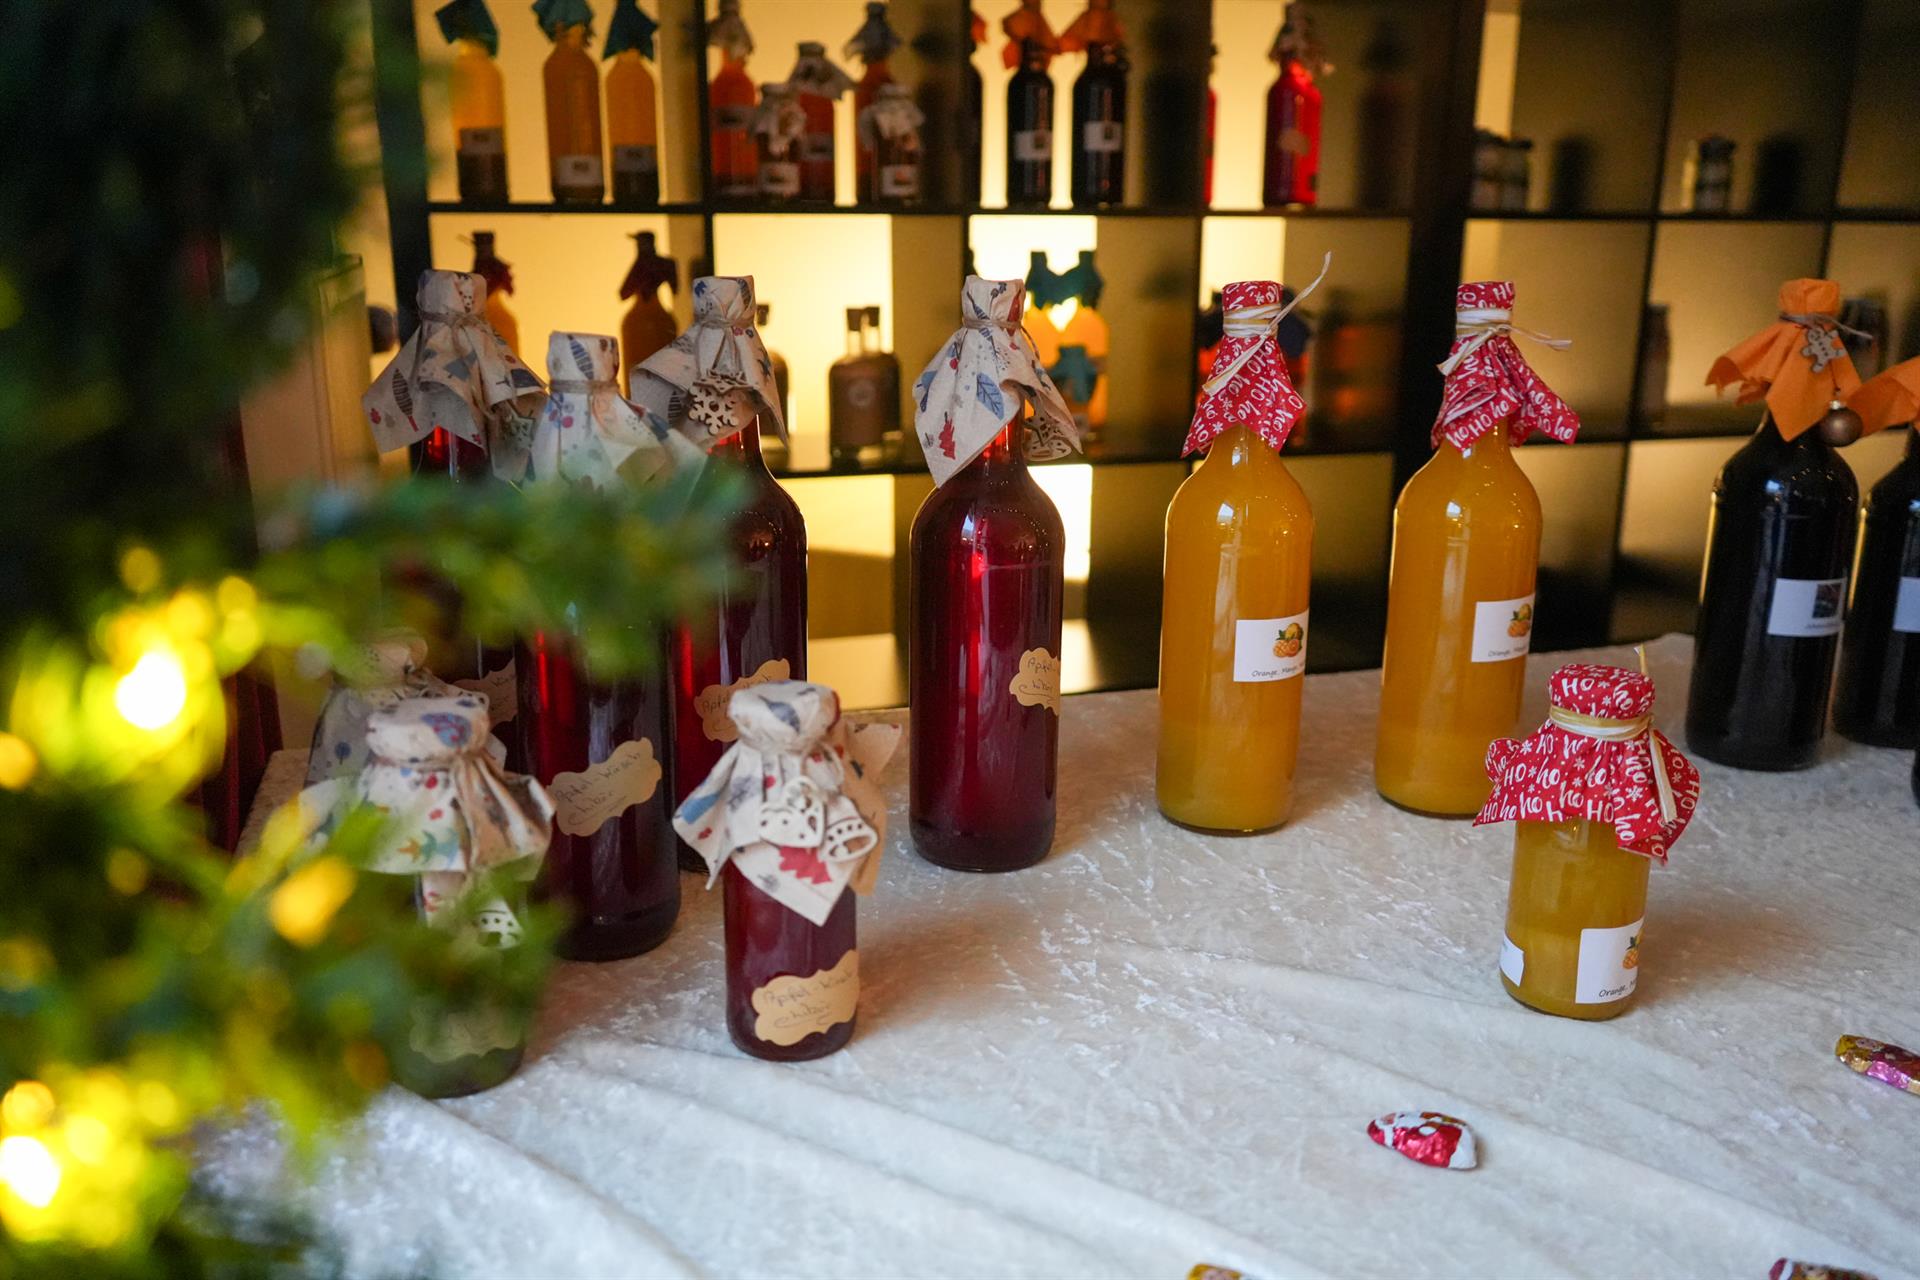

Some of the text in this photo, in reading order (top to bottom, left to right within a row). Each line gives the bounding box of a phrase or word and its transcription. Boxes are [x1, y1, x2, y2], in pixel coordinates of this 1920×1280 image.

[1468, 413, 1492, 437] HO
[1490, 400, 1509, 419] ho
[1554, 415, 1574, 441] ho
[1561, 678, 1595, 698] HO
[1612, 681, 1634, 711] ho
[1503, 762, 1527, 787] HO
[1535, 756, 1561, 790] ho
[1483, 801, 1499, 823] HO
[1500, 793, 1518, 821] ho
[1520, 792, 1543, 820] ho
[1587, 799, 1614, 823] HO
[1558, 780, 1584, 809] ho
[1615, 813, 1641, 841] ho
